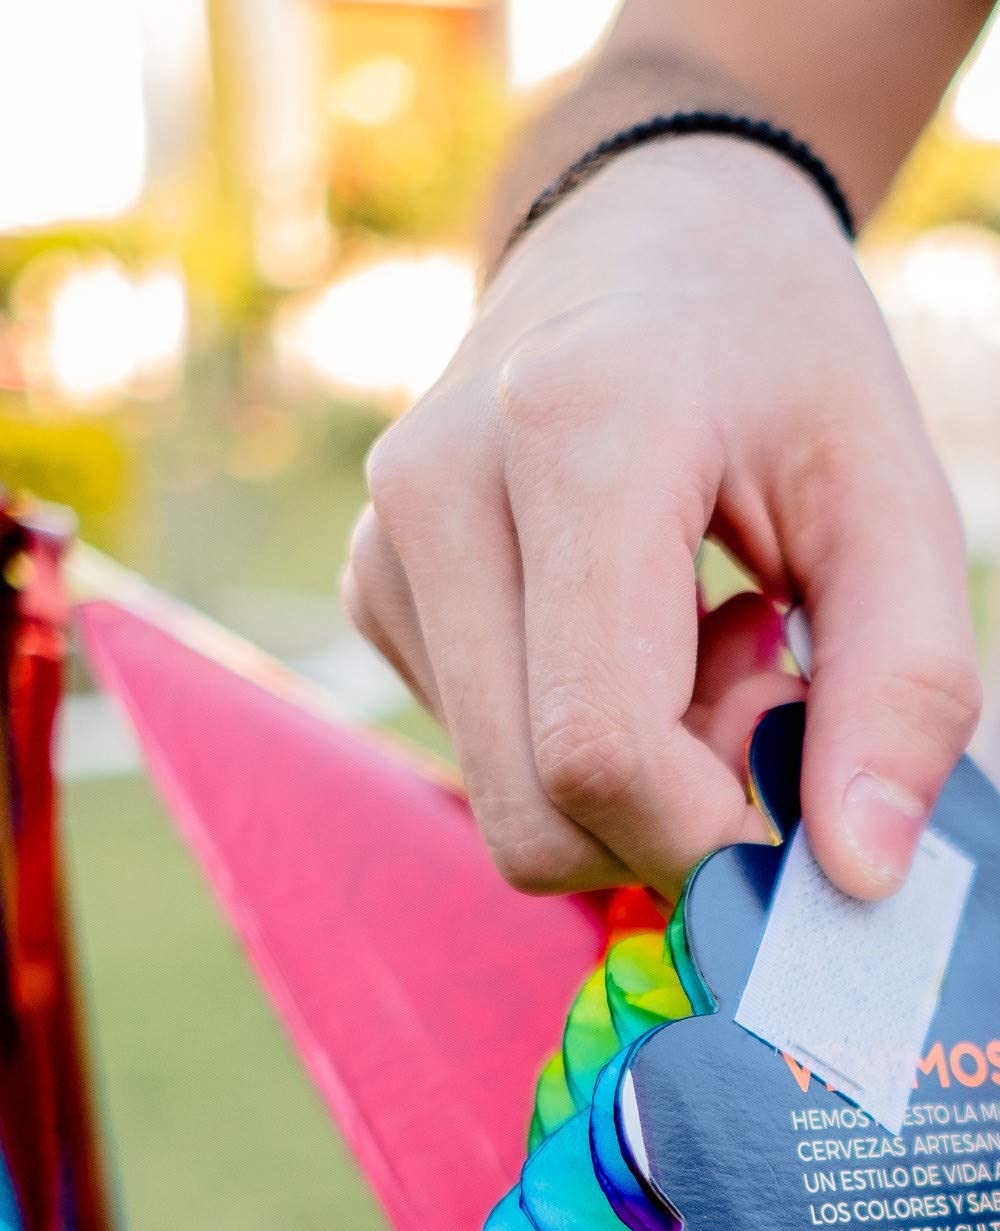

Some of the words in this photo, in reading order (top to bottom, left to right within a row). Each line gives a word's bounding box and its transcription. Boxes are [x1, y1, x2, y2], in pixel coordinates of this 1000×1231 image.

[791, 1109, 870, 1131] HEMOS
[876, 1105, 949, 1128] ESTO
[953, 1103, 977, 1124] LA
[797, 1137, 906, 1162] CERVEZAS
[804, 1172, 837, 1193] UN
[841, 1168, 909, 1190] ESTILO
[913, 1165, 942, 1186] DE
[942, 1163, 991, 1185] VIDA
[810, 1203, 851, 1225] LOS
[854, 1196, 949, 1222] COLORES
[949, 1194, 963, 1214] Y
